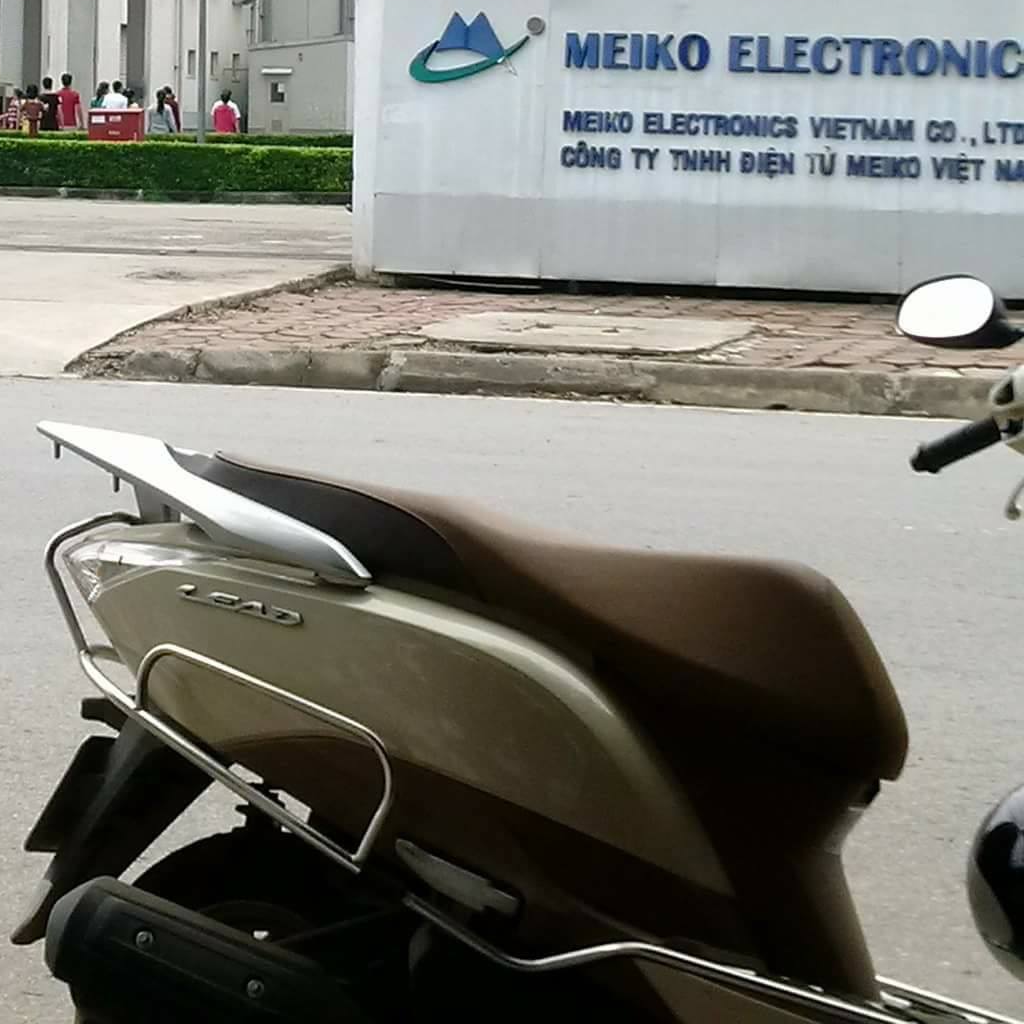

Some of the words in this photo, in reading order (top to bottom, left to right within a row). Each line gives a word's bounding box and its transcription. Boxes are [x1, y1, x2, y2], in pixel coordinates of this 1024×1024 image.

[565, 33, 710, 71] MEIKO
[728, 36, 1024, 78] ELECTRONIC
[562, 111, 633, 133] MEIKO
[643, 112, 798, 138] ELECTRONICS
[810, 117, 914, 142] VIETNAM
[561, 140, 621, 169] CÔNG
[631, 148, 659, 170] TY
[670, 149, 730, 172] TNHH
[739, 148, 794, 178] ĐIỆN
[846, 155, 921, 178] MEIKO
[931, 153, 985, 183] VIỆT
[176, 584, 304, 626] LEAD
